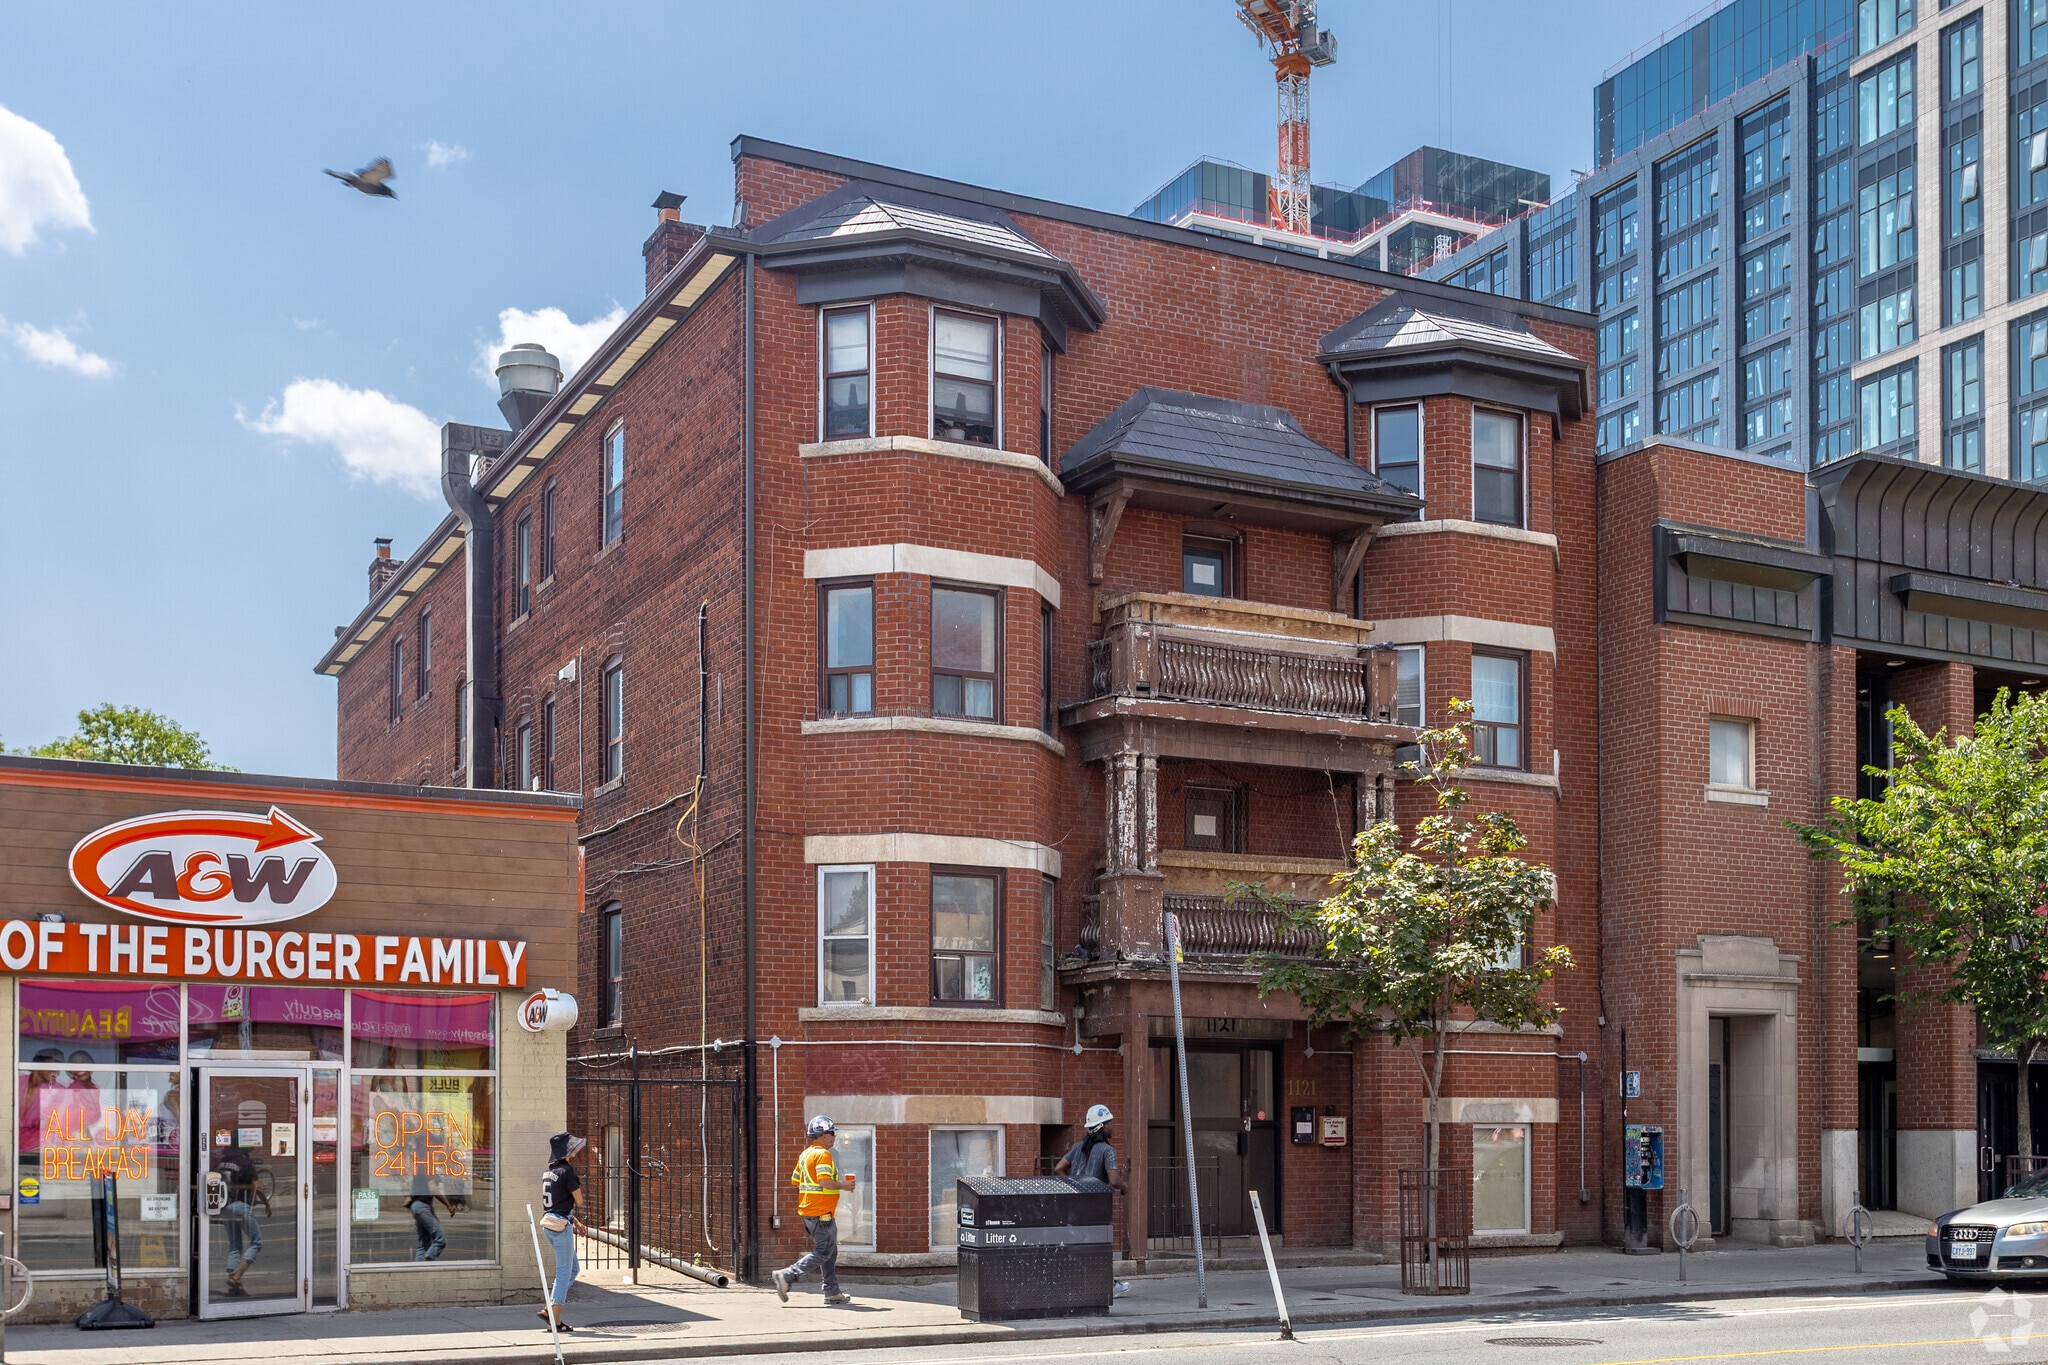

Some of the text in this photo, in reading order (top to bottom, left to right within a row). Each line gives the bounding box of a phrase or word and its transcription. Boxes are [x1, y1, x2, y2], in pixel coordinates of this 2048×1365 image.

[105, 849, 319, 904] A&W
[0, 920, 527, 986] OF THE BURGER FAMILY
[529, 1005, 548, 1024] A&W
[1288, 1080, 1317, 1096] 1121
[44, 1107, 154, 1141] ALL DAY
[374, 1110, 469, 1149] OPEN
[43, 1145, 153, 1181] BREAKFAST
[374, 1150, 406, 1177] 24
[412, 1150, 468, 1177] HRS.
[358, 1191, 376, 1199] PASS
[965, 1231, 976, 1243] Litter
[985, 1232, 1006, 1244] Litter
